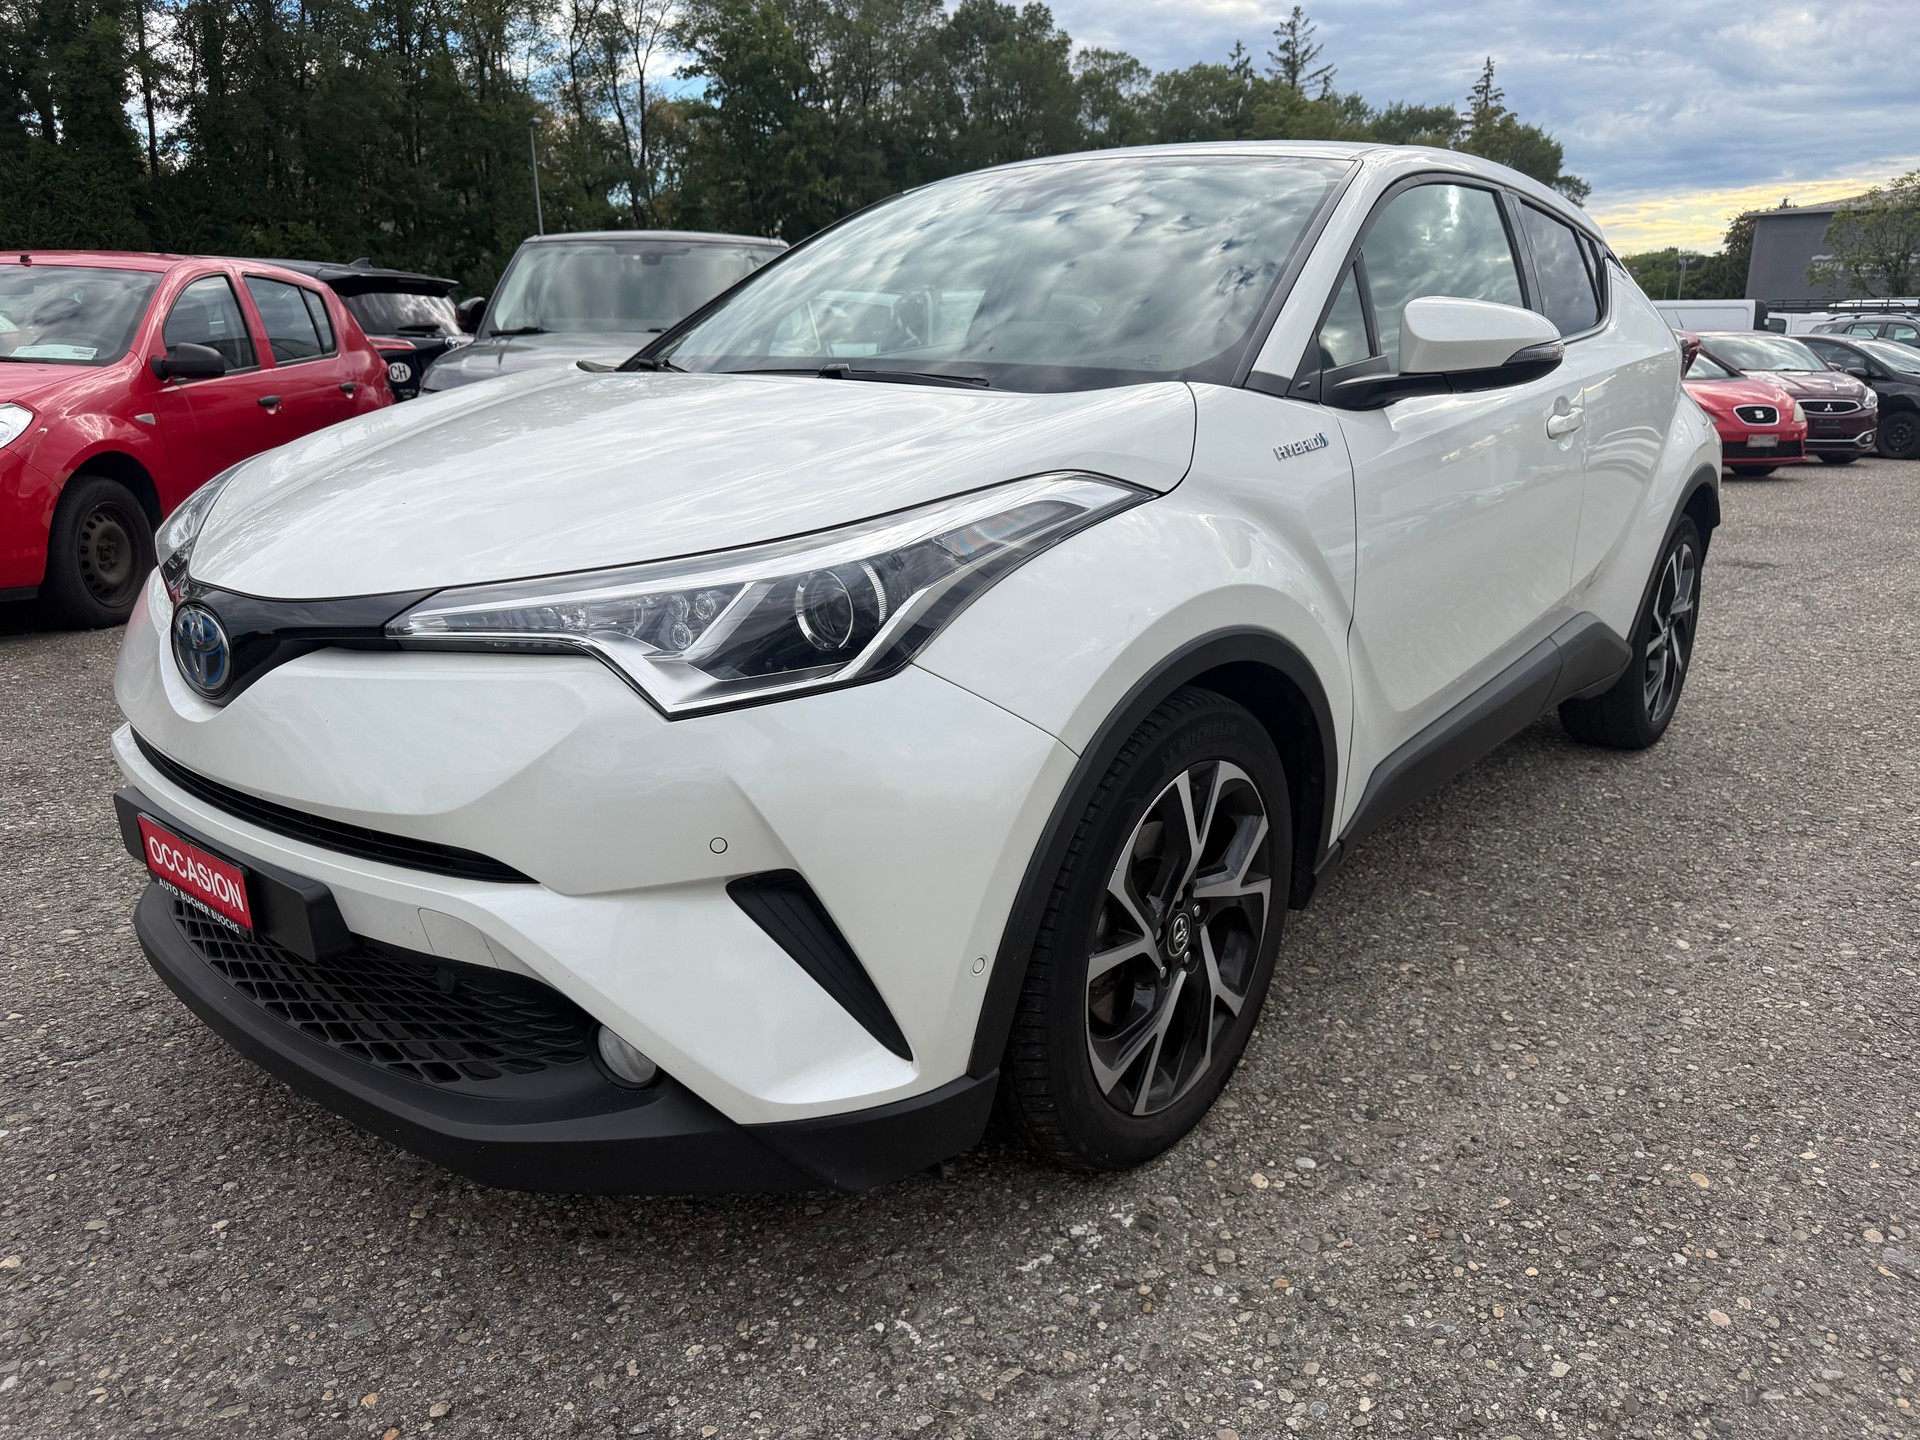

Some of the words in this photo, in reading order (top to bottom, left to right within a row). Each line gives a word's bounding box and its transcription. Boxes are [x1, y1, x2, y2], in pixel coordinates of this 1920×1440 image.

[389, 365, 408, 381] CH
[1272, 437, 1322, 461] HYBRID
[149, 836, 244, 912] OCCASION
[159, 878, 179, 896] AUTO
[180, 891, 210, 916] BUCHER
[211, 909, 240, 934] BUOCHS
